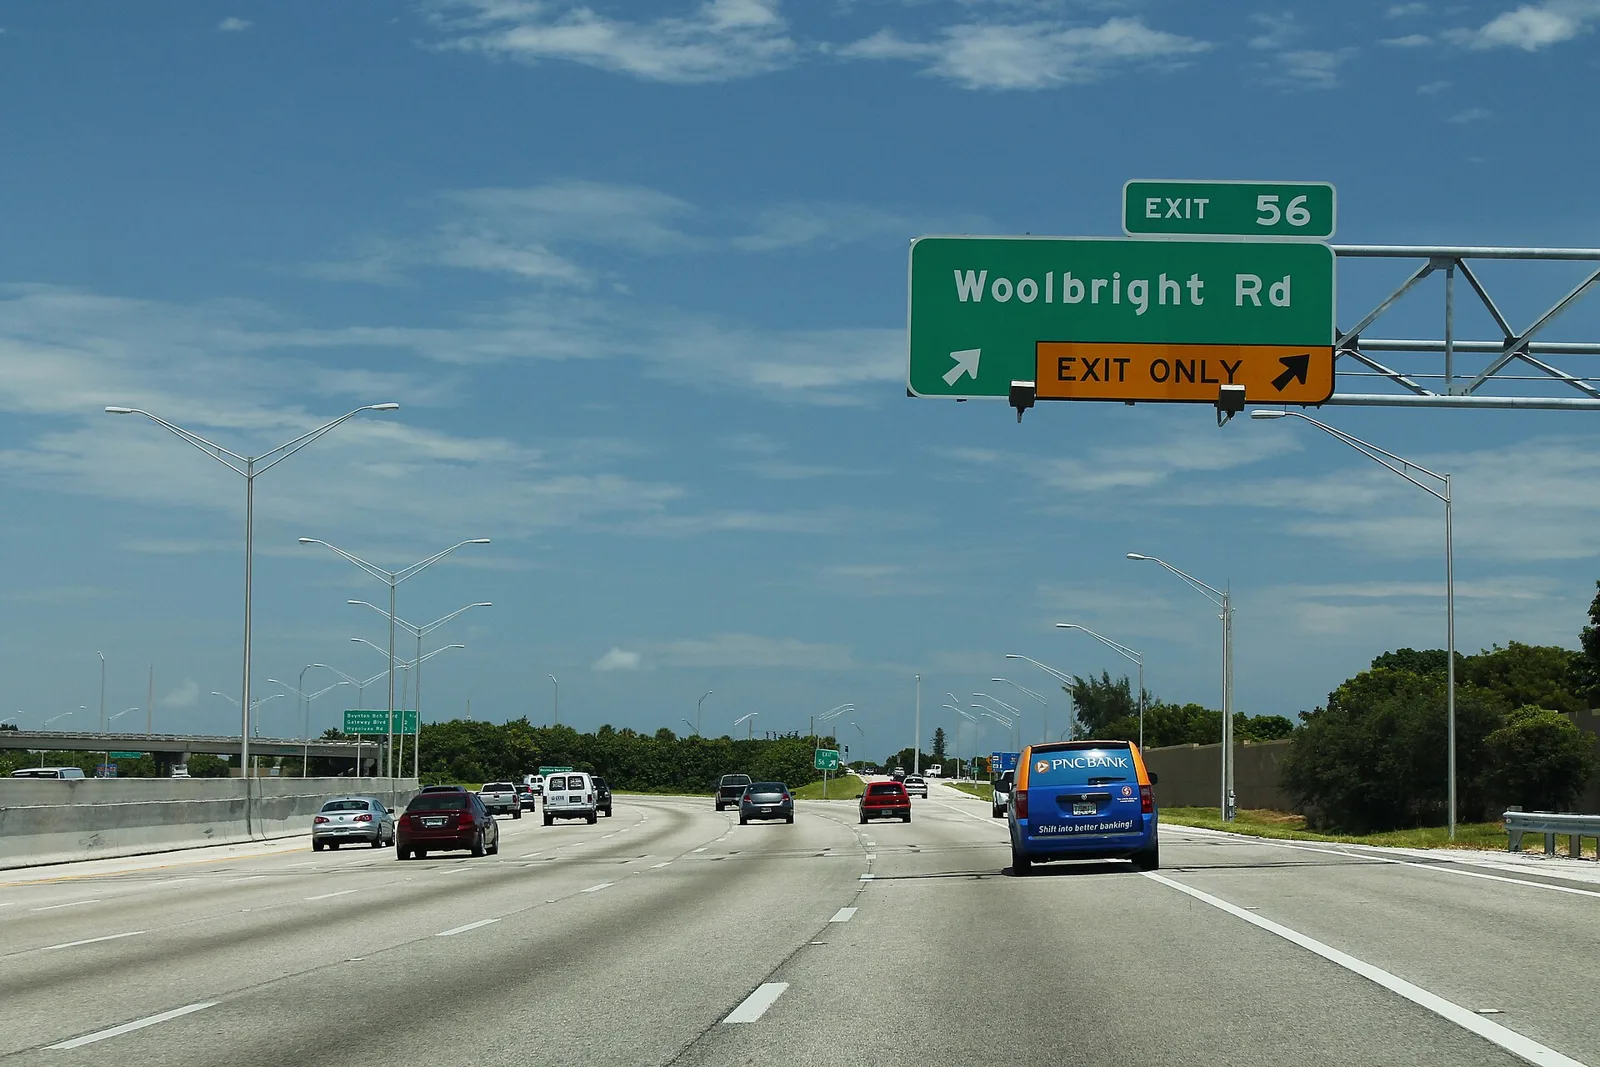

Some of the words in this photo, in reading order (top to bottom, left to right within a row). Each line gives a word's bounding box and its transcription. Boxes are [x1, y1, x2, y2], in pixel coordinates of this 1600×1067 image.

[1145, 197, 1210, 219] EXIT
[1256, 194, 1311, 227] 56
[953, 269, 1205, 316] Woolbright
[1234, 273, 1291, 307] Rd
[1057, 357, 1131, 383] EXIT
[1149, 358, 1243, 385] ONLY
[1052, 757, 1086, 770] PNC
[1087, 757, 1129, 769] BANK
[1039, 825, 1057, 834] Shift
[1074, 824, 1098, 832] better
[1100, 820, 1133, 830] banking!
